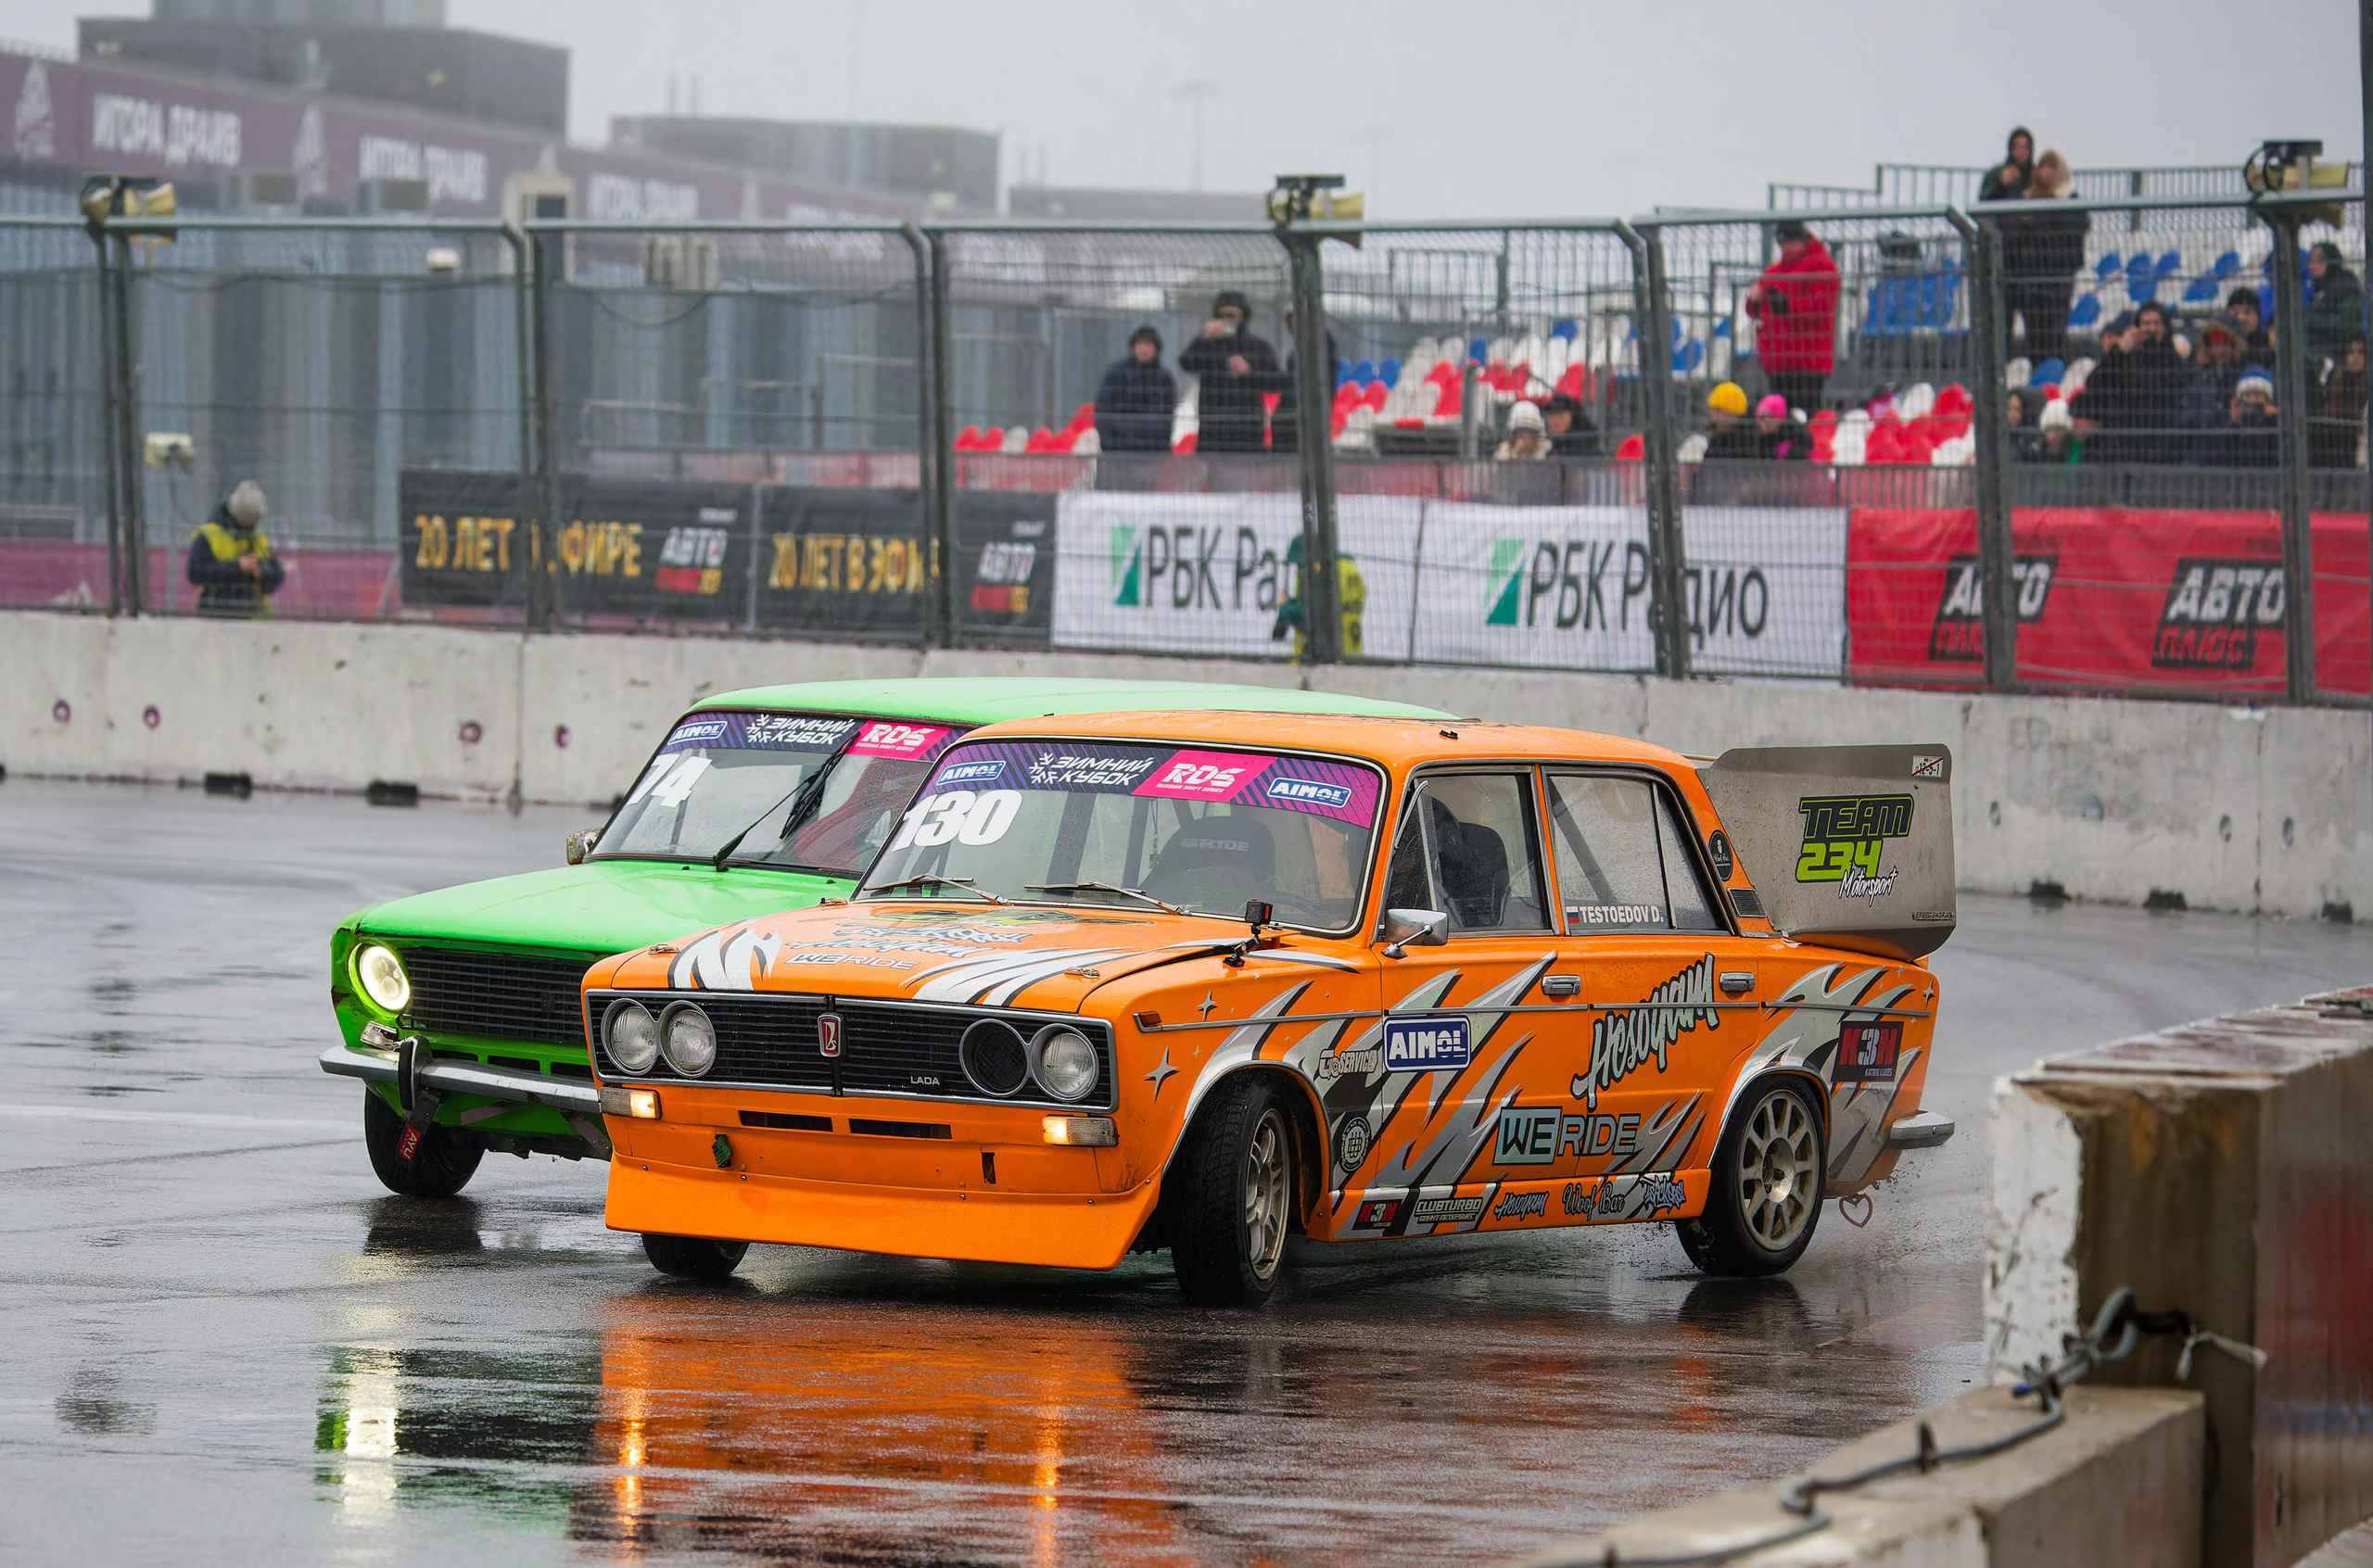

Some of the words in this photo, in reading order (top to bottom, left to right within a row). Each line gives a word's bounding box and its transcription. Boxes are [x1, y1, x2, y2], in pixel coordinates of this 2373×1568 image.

[1147, 525, 1223, 610] РБК
[1528, 539, 1617, 631] РБК
[1942, 563, 2051, 618] АО
[2164, 566, 2286, 624] АВТО
[2158, 626, 2249, 664] ПЛЮС
[672, 724, 720, 741] AIMOL
[767, 717, 856, 734] ЗИМНИЙ
[770, 730, 843, 745] КУБОК
[861, 724, 936, 747] RDS
[940, 765, 1002, 782] AIMOL
[1051, 755, 1155, 773] ЗИМНИЙ
[1161, 763, 1247, 788] RDS
[626, 753, 713, 808] 74
[1058, 770, 1139, 786] КУБОК
[1271, 782, 1346, 804] AIMOL
[892, 790, 1022, 852] 130
[1799, 796, 1913, 839] TEAM
[1796, 840, 1883, 881] 234
[1839, 866, 1898, 906] Motorsport
[1579, 905, 1649, 923] TESTOEDOV
[1651, 905, 1664, 923] D.
[1389, 1030, 1466, 1060] AIMOL
[910, 1076, 940, 1085] LADA
[1415, 1198, 1483, 1213] CLUBTURBO
[1562, 1182, 1597, 1221] Woof
[1598, 1182, 1625, 1214] Bar
